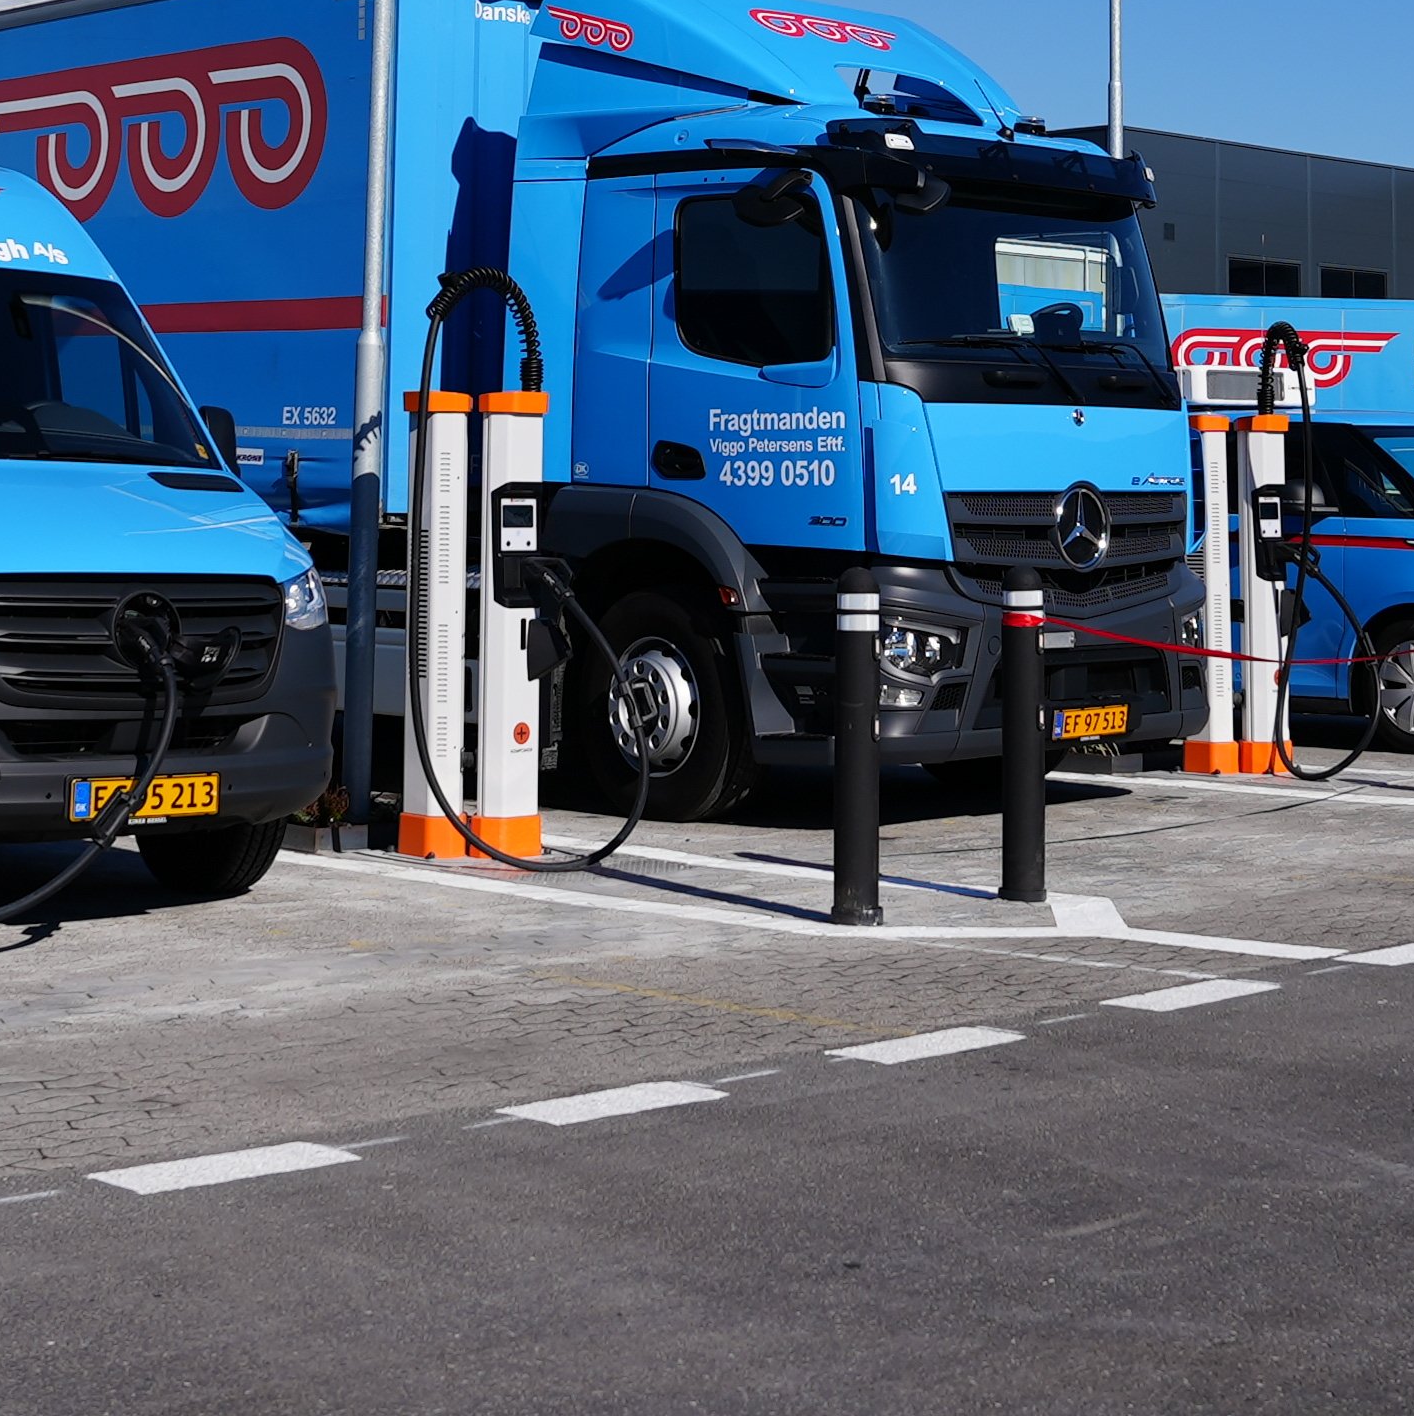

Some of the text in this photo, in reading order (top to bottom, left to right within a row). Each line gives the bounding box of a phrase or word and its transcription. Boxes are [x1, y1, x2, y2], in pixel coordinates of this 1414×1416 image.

[475, 0, 531, 25] Danske
[282, 406, 336, 425] EX 5632
[709, 407, 846, 436] Fragtmanden
[710, 436, 846, 456] Viggo Petersens Eftf.
[719, 460, 835, 486] 4399 0510
[890, 472, 917, 495] 14
[1064, 711, 1125, 734] EF 97 513
[171, 781, 215, 809] 213
